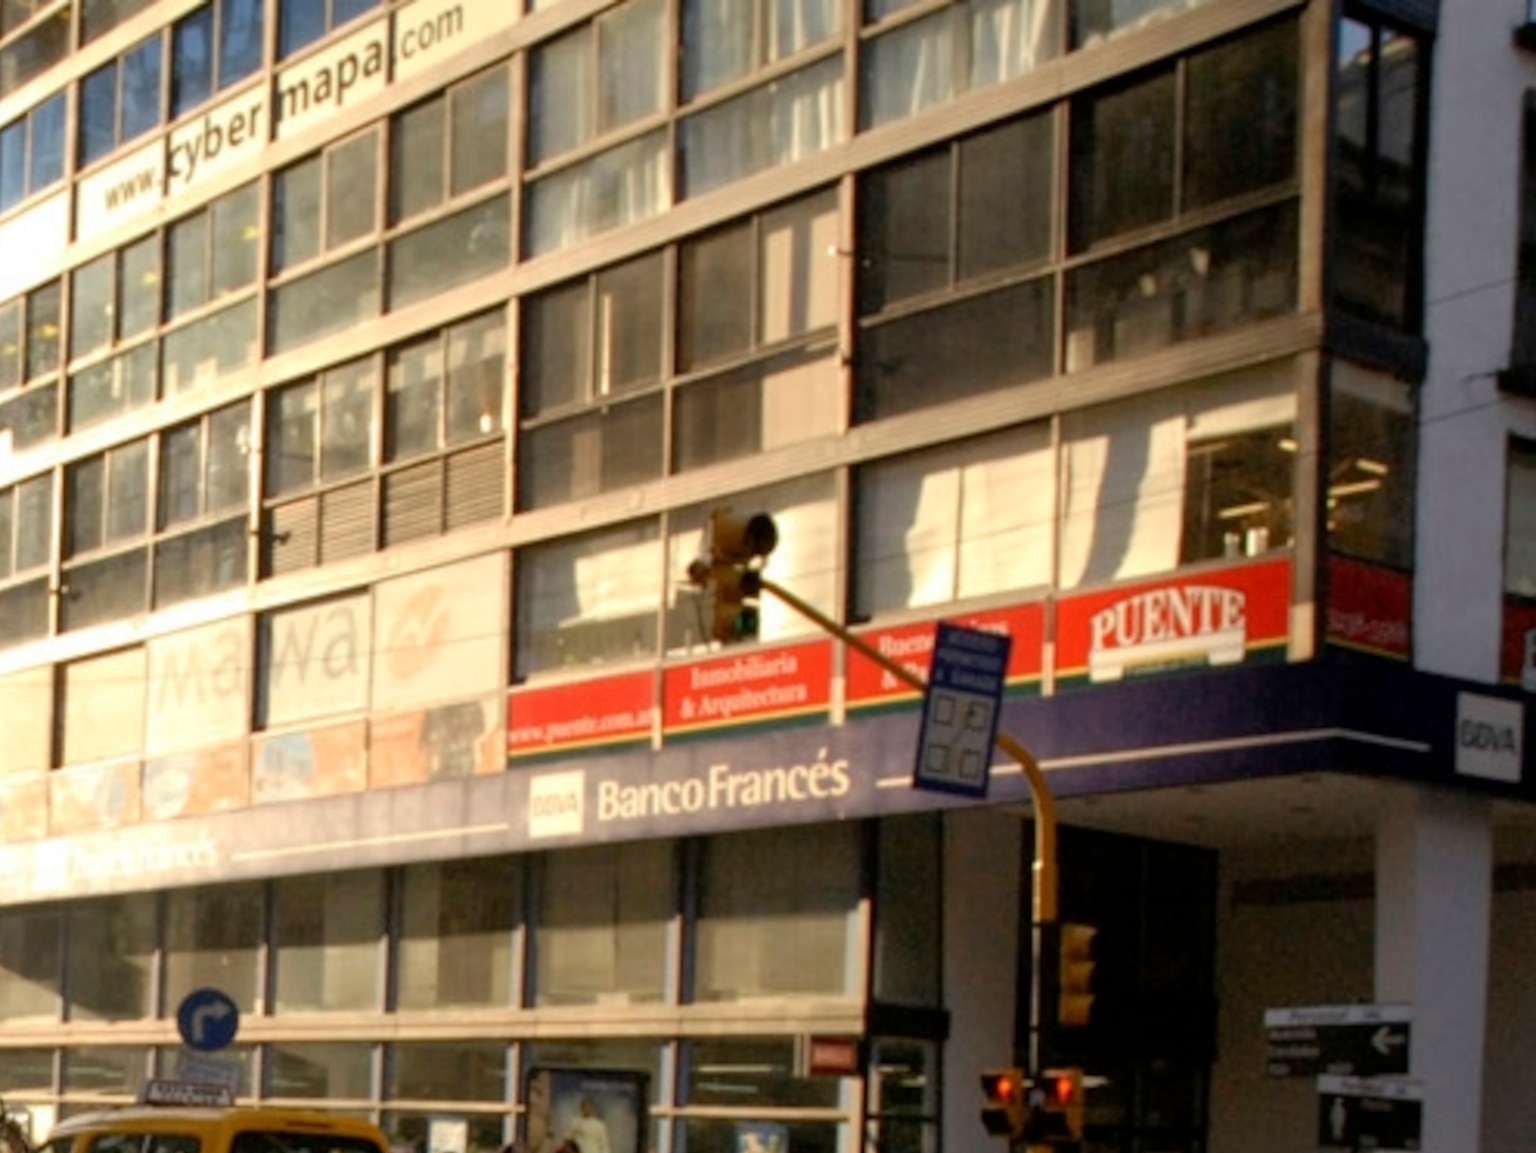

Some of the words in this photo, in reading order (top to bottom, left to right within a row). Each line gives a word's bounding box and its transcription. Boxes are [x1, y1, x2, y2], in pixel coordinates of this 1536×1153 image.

[1091, 585, 1246, 650] PUENTE
[690, 651, 798, 689] Inmobiliaria
[679, 697, 695, 719] &
[697, 683, 808, 717] Arquitectura
